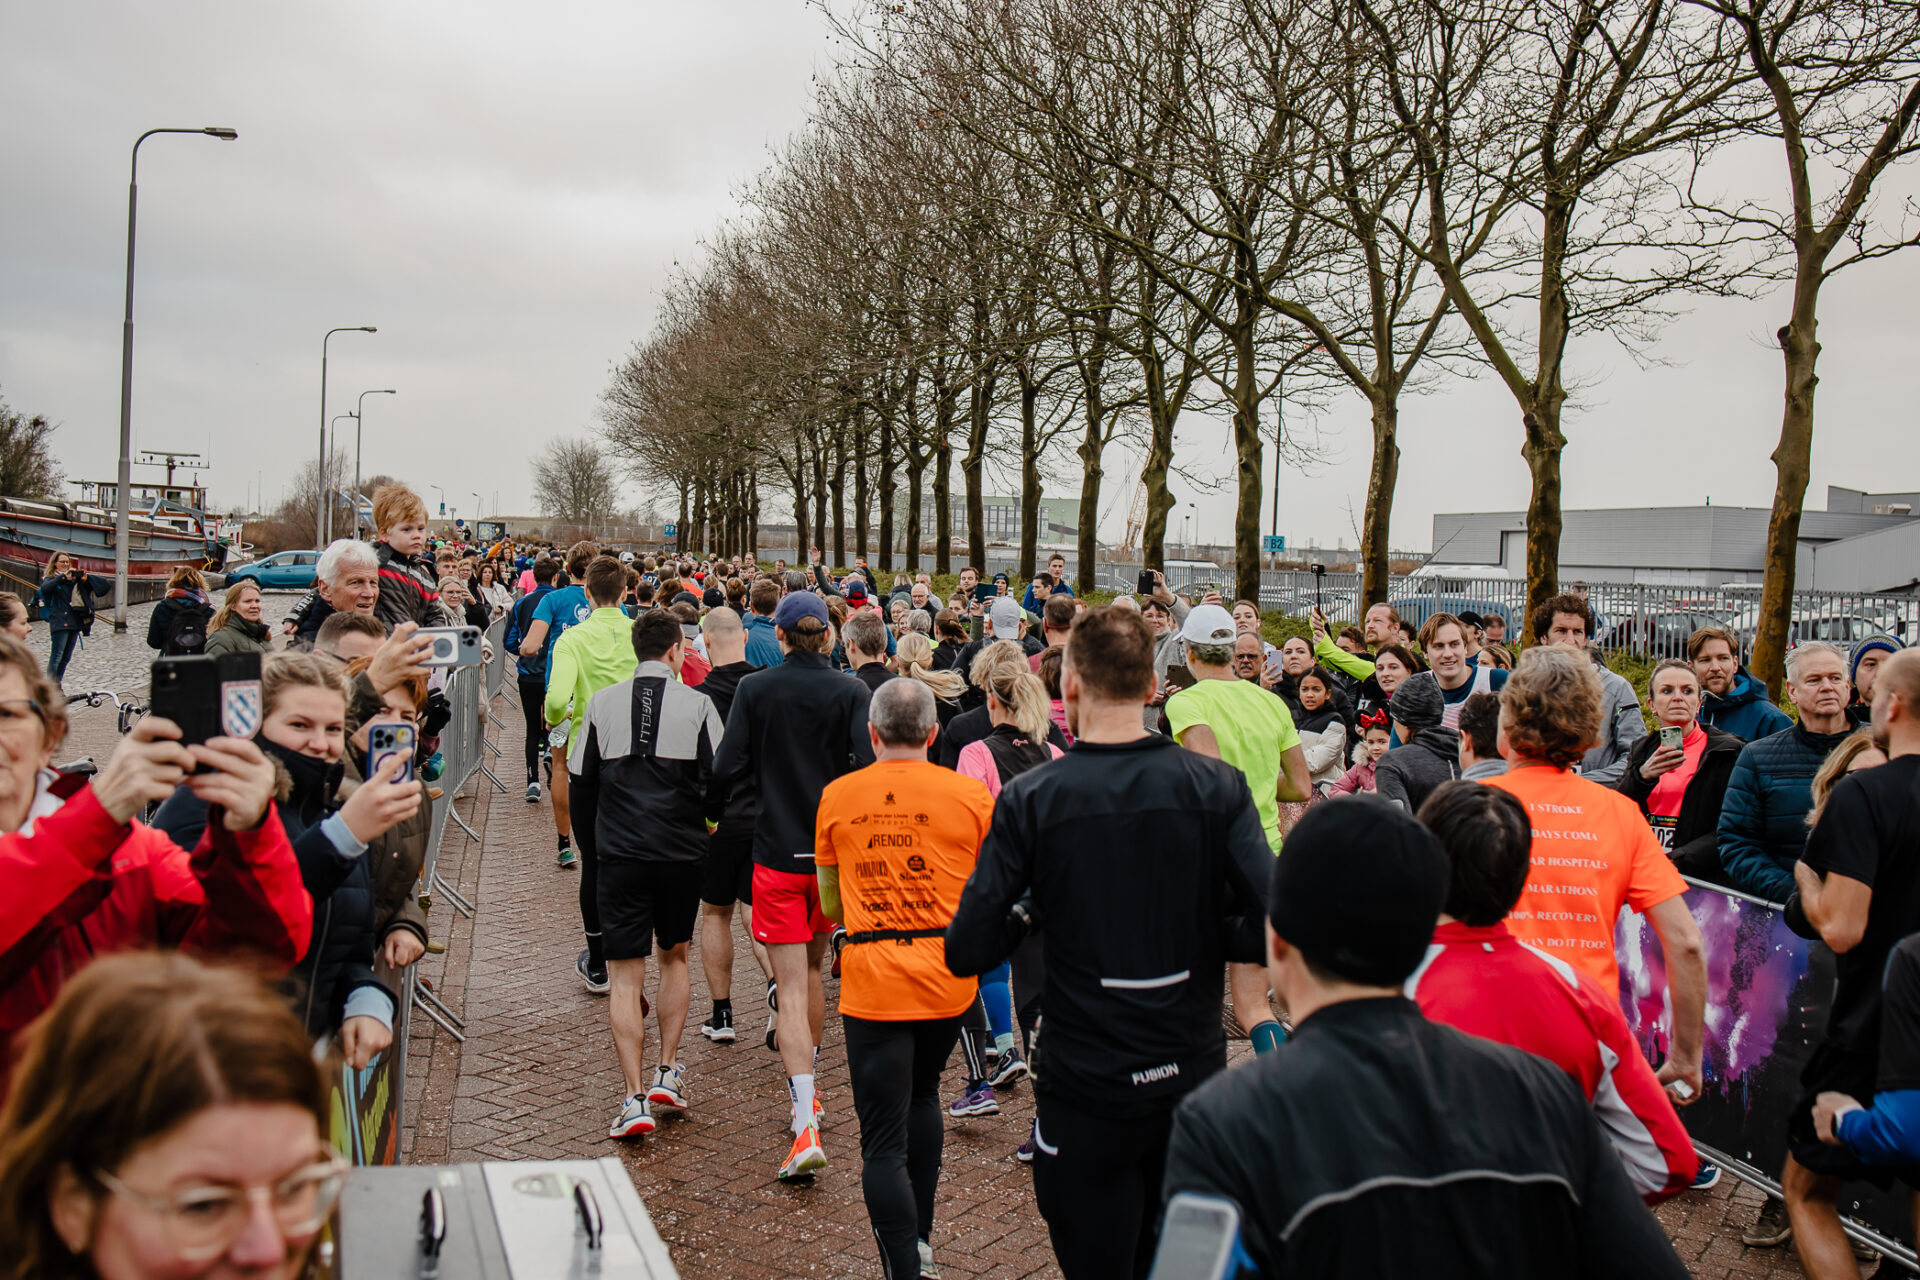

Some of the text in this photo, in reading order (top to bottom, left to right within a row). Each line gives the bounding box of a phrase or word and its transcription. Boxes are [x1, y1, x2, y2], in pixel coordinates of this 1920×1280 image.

[1271, 538, 1283, 549] B2
[640, 687, 653, 744] ROGELLI
[1537, 804, 1584, 814] STROKE
[873, 834, 912, 847] RENDO
[1531, 828, 1599, 841] DAYS COMA
[1530, 856, 1608, 870] AR HOSPITALS
[1528, 884, 1598, 896] MARATHONS
[1509, 911, 1597, 923] 100% RECOVERY
[1547, 938, 1564, 948] DO
[1566, 939, 1576, 948] IT
[1131, 1062, 1179, 1086] FUSION
